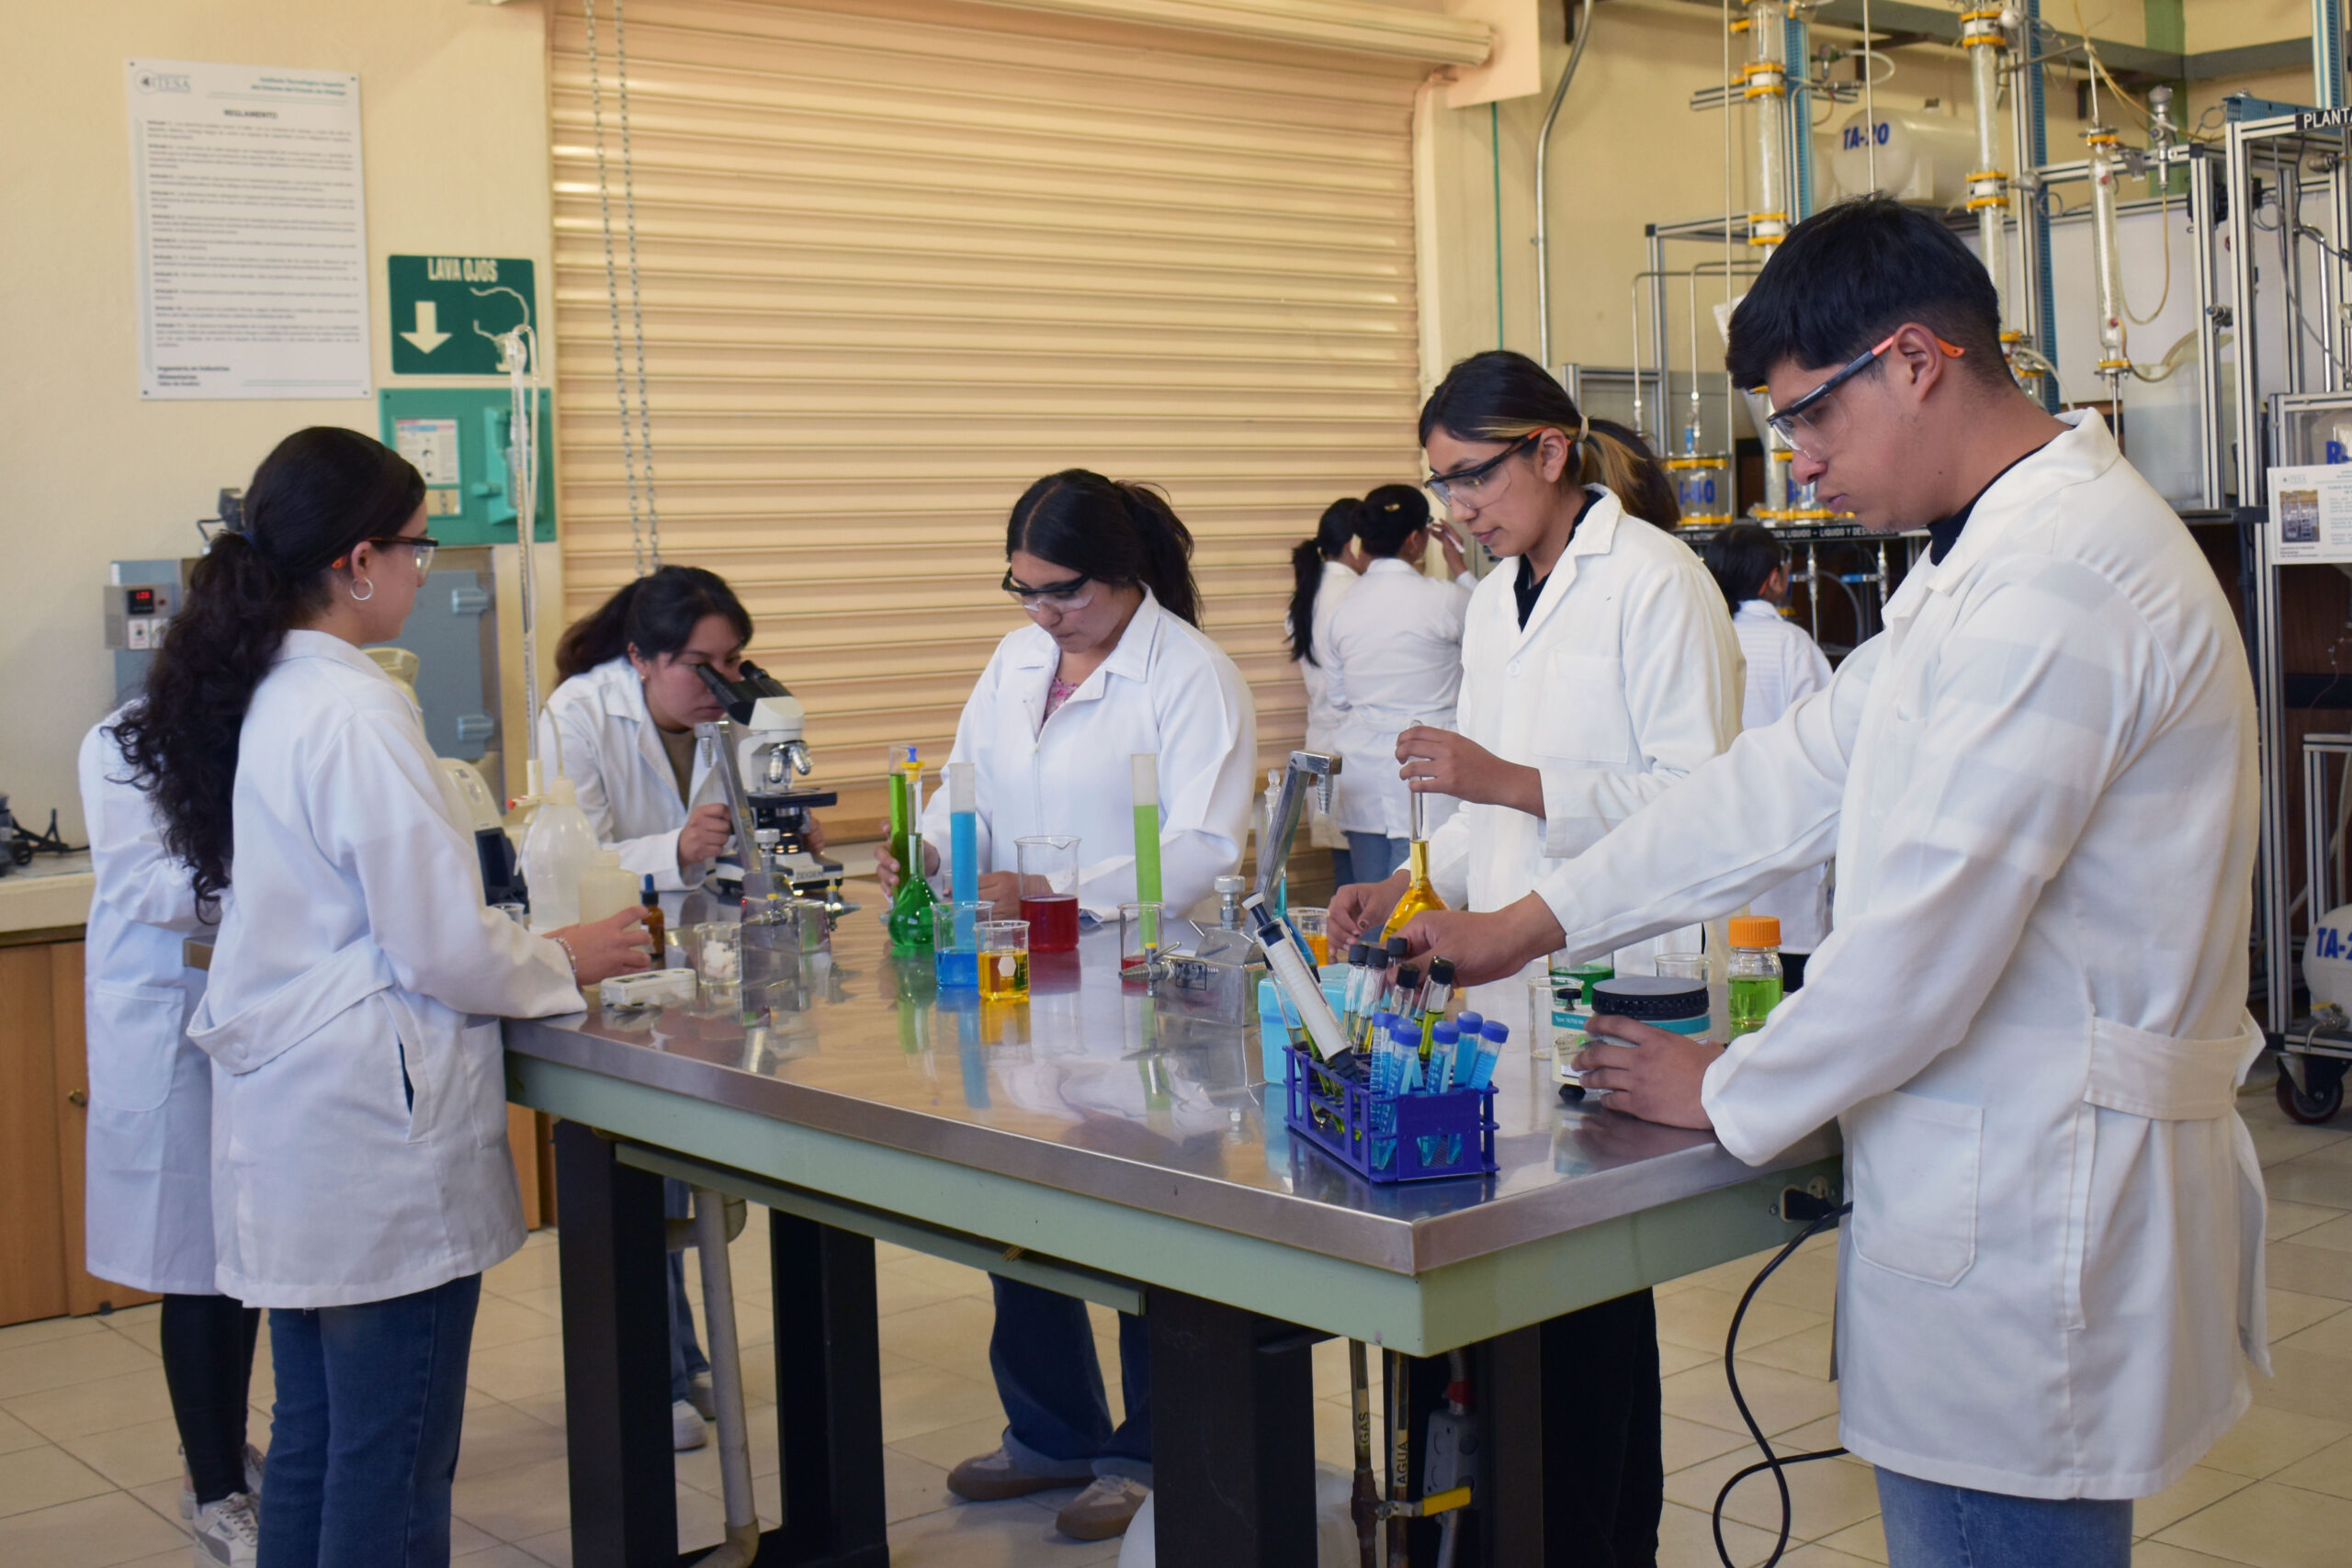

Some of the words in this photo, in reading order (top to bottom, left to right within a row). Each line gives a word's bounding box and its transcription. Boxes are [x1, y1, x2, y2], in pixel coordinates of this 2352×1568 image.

[2303, 107, 2352, 130] PLANT
[427, 257, 462, 281] LAVA
[462, 258, 498, 283] OJOS
[1359, 1412, 1370, 1444] GAS
[1396, 1441, 1408, 1484] AGUA
